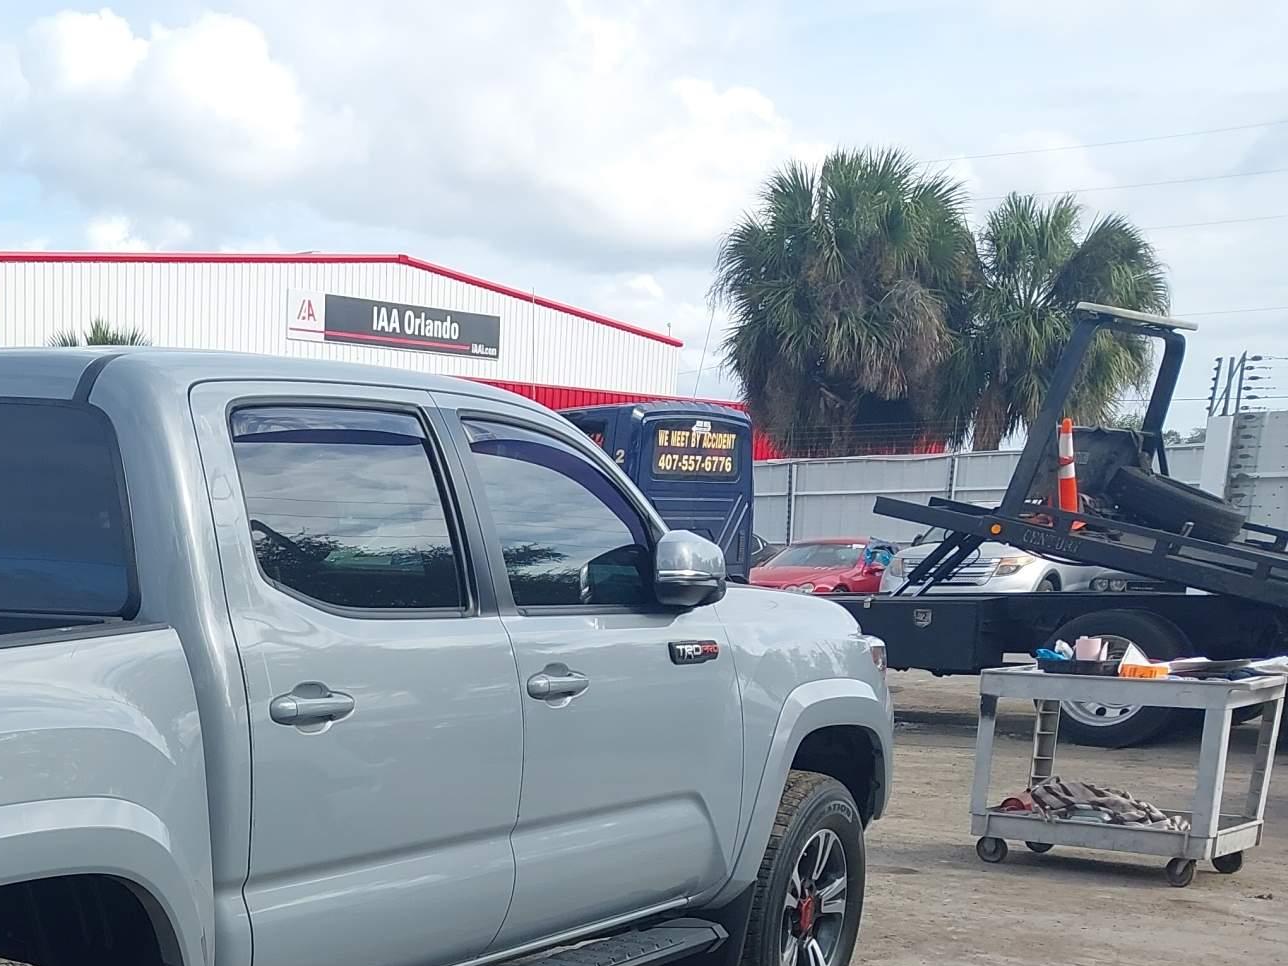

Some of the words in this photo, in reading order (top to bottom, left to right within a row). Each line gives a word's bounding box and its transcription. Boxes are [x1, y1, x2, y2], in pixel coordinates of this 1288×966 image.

[372, 305, 400, 333] IAA
[404, 310, 460, 340] Orlando
[658, 429, 669, 446] WE
[670, 431, 690, 448] MEET
[691, 431, 702, 448] BY
[702, 432, 737, 450] ACCIDENT
[615, 449, 625, 464] 2
[658, 453, 732, 472] 407-557-6776
[676, 644, 702, 660] TRD
